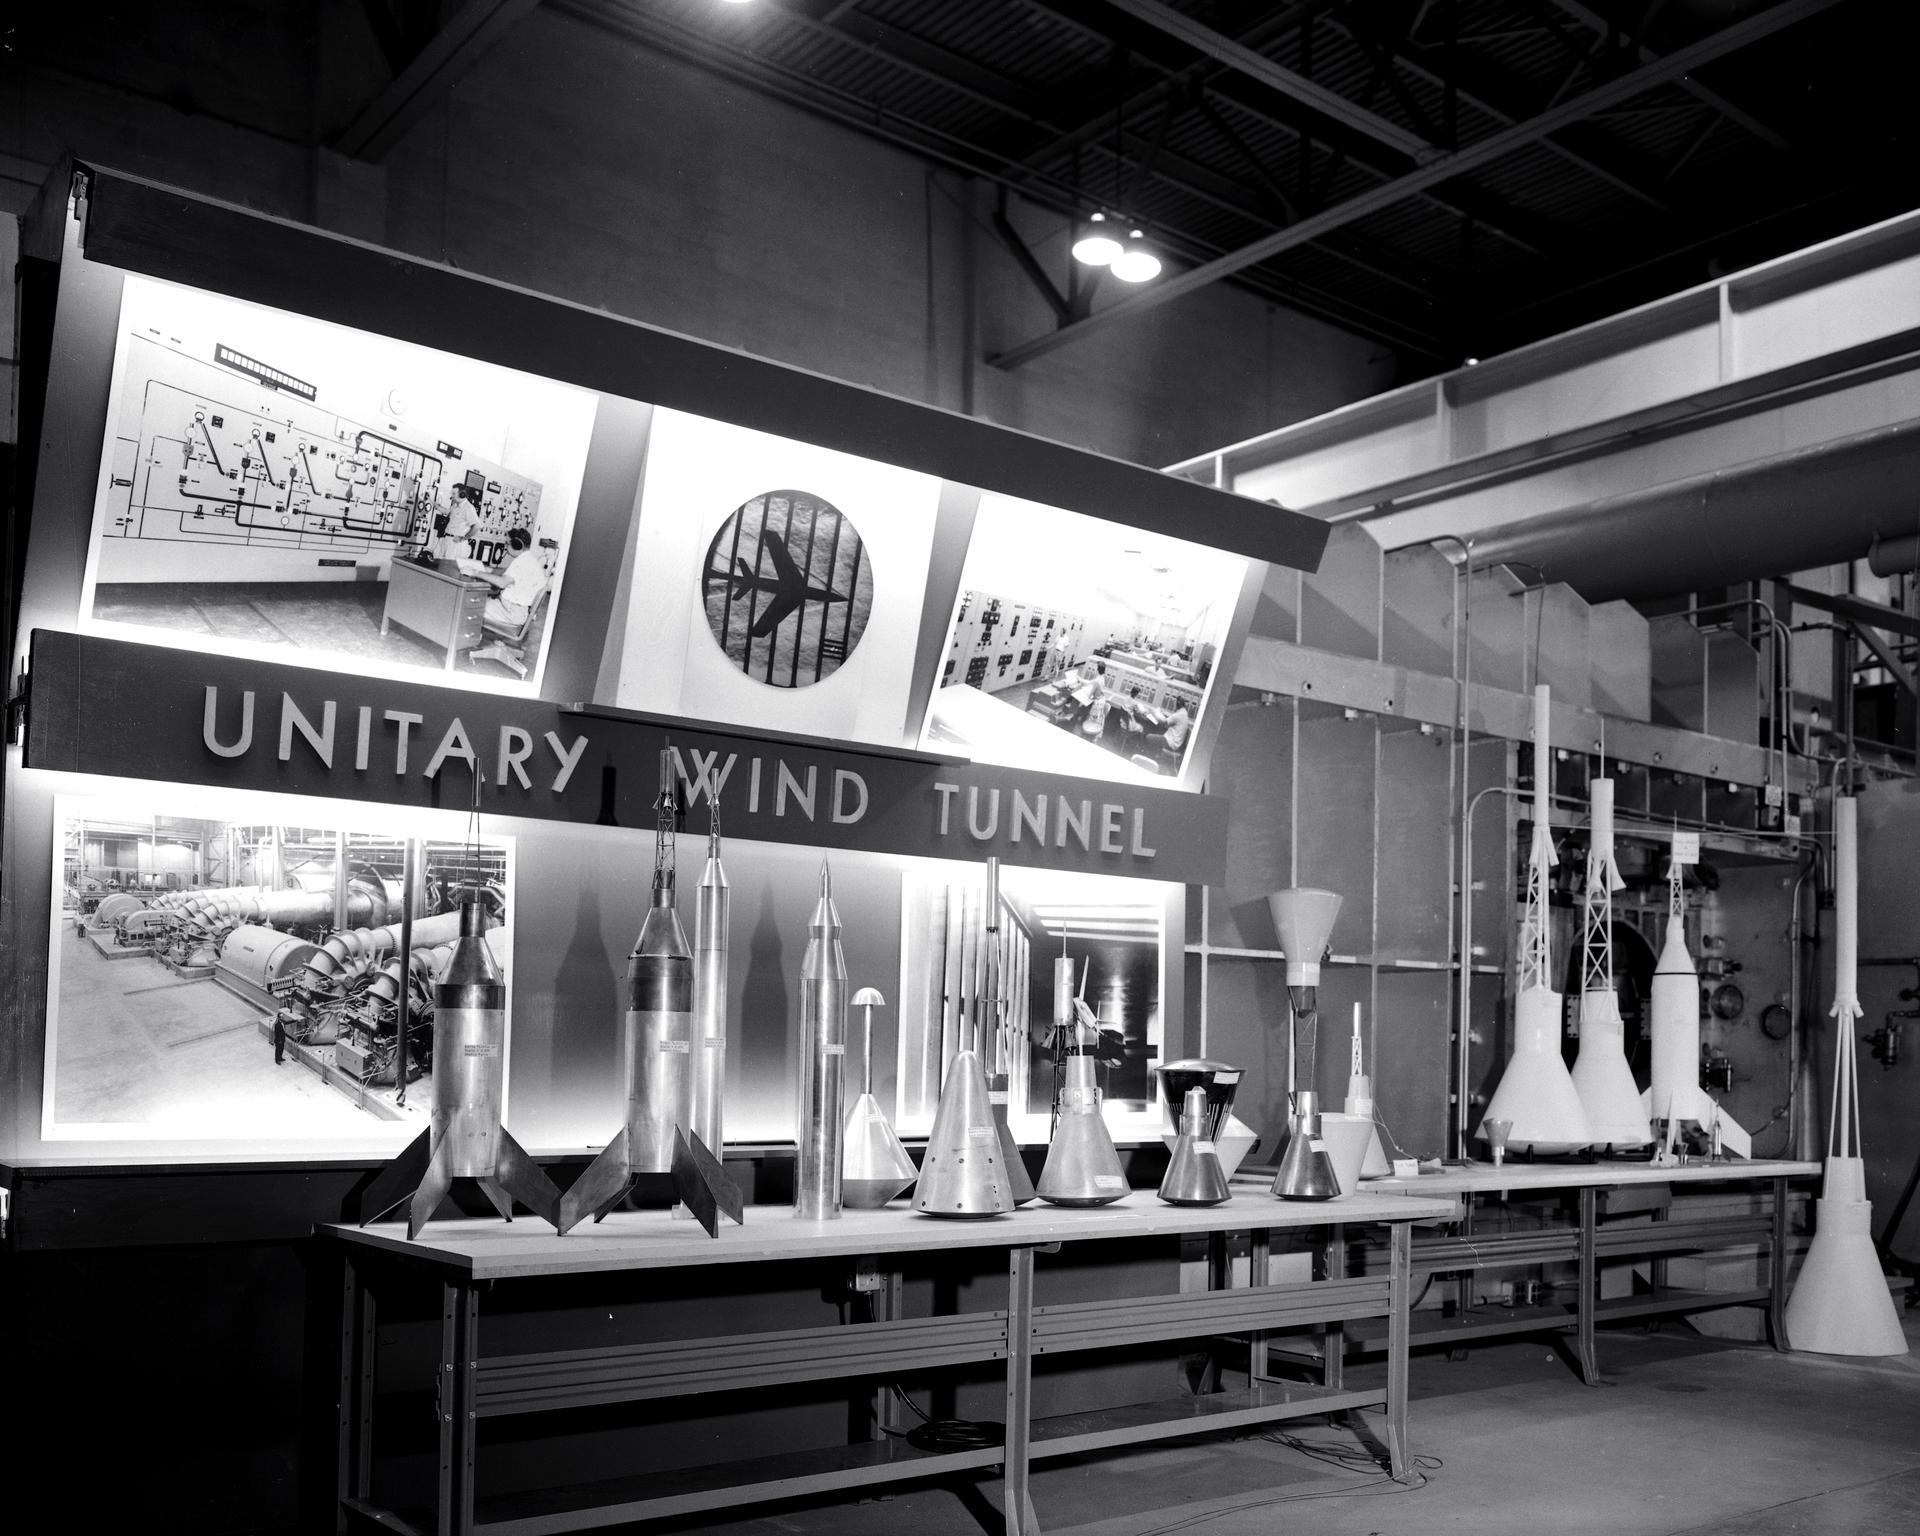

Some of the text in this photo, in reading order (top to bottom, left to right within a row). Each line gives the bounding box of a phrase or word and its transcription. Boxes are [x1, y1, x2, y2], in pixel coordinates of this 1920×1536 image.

[203, 685, 1157, 858] UNITARY WIND TUNNEL
